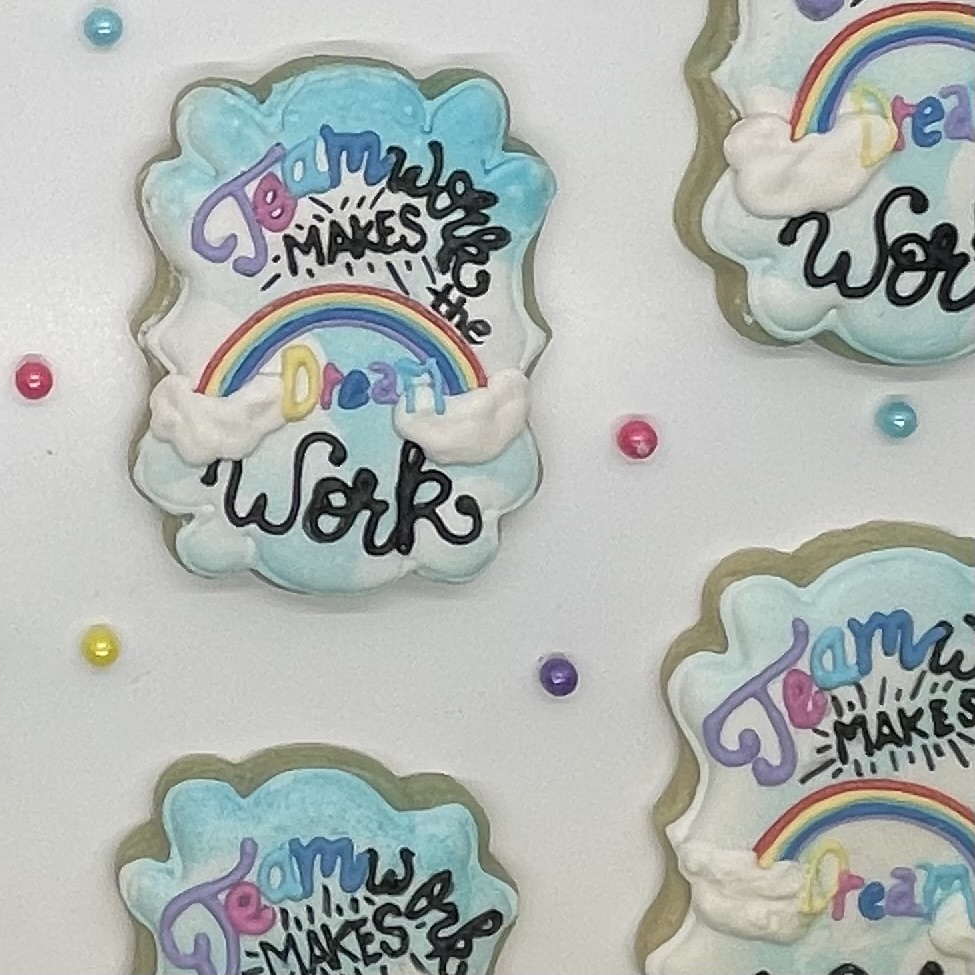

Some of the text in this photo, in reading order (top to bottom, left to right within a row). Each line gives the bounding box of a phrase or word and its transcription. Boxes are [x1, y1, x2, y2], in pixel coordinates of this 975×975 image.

[284, 205, 426, 276] MAKES
[426, 281, 492, 344] the
[280, 344, 446, 422] Dream
[201, 431, 482, 555] Work
[800, 838, 975, 928] Dream
[259, 902, 411, 975] MAKES
